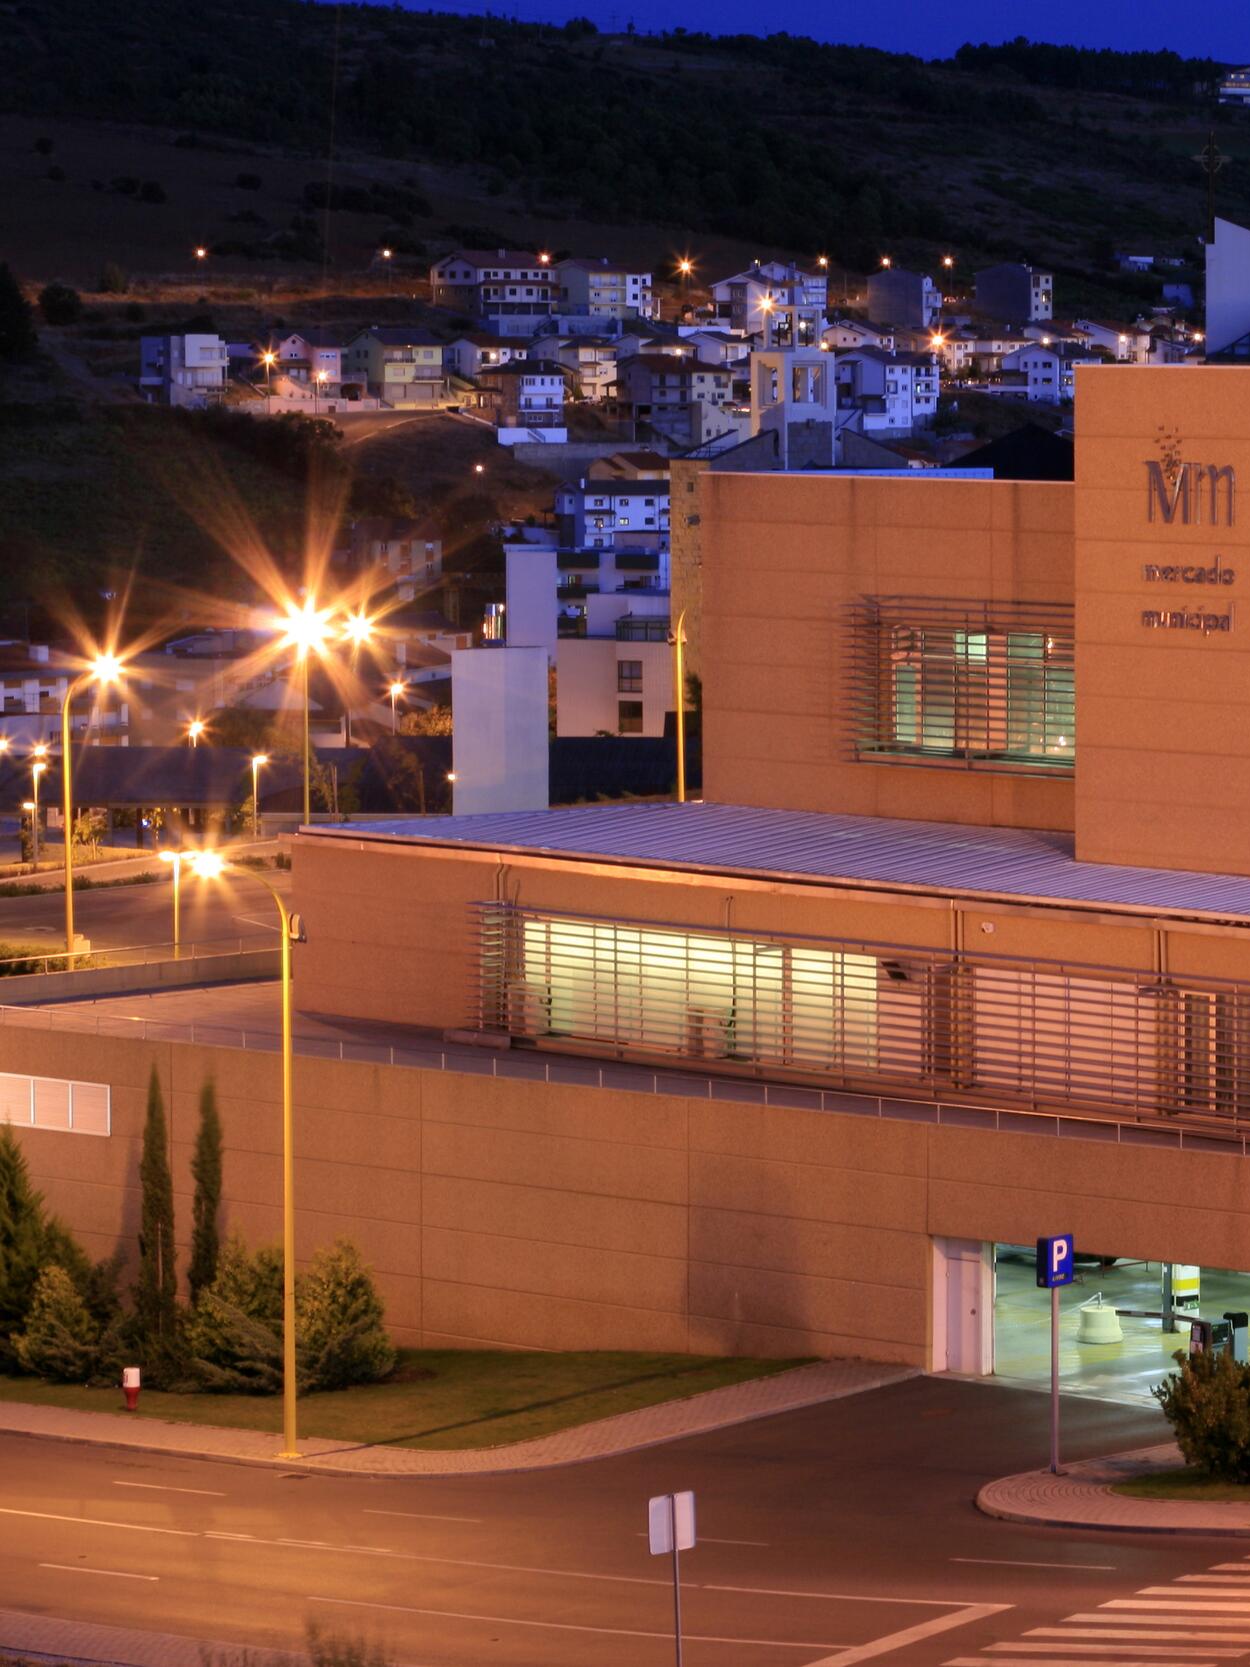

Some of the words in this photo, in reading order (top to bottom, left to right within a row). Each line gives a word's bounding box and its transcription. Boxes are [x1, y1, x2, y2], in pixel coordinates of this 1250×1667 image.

[1144, 555, 1235, 585] mercado
[1142, 601, 1235, 637] municipal
[1053, 1239, 1068, 1272] P
